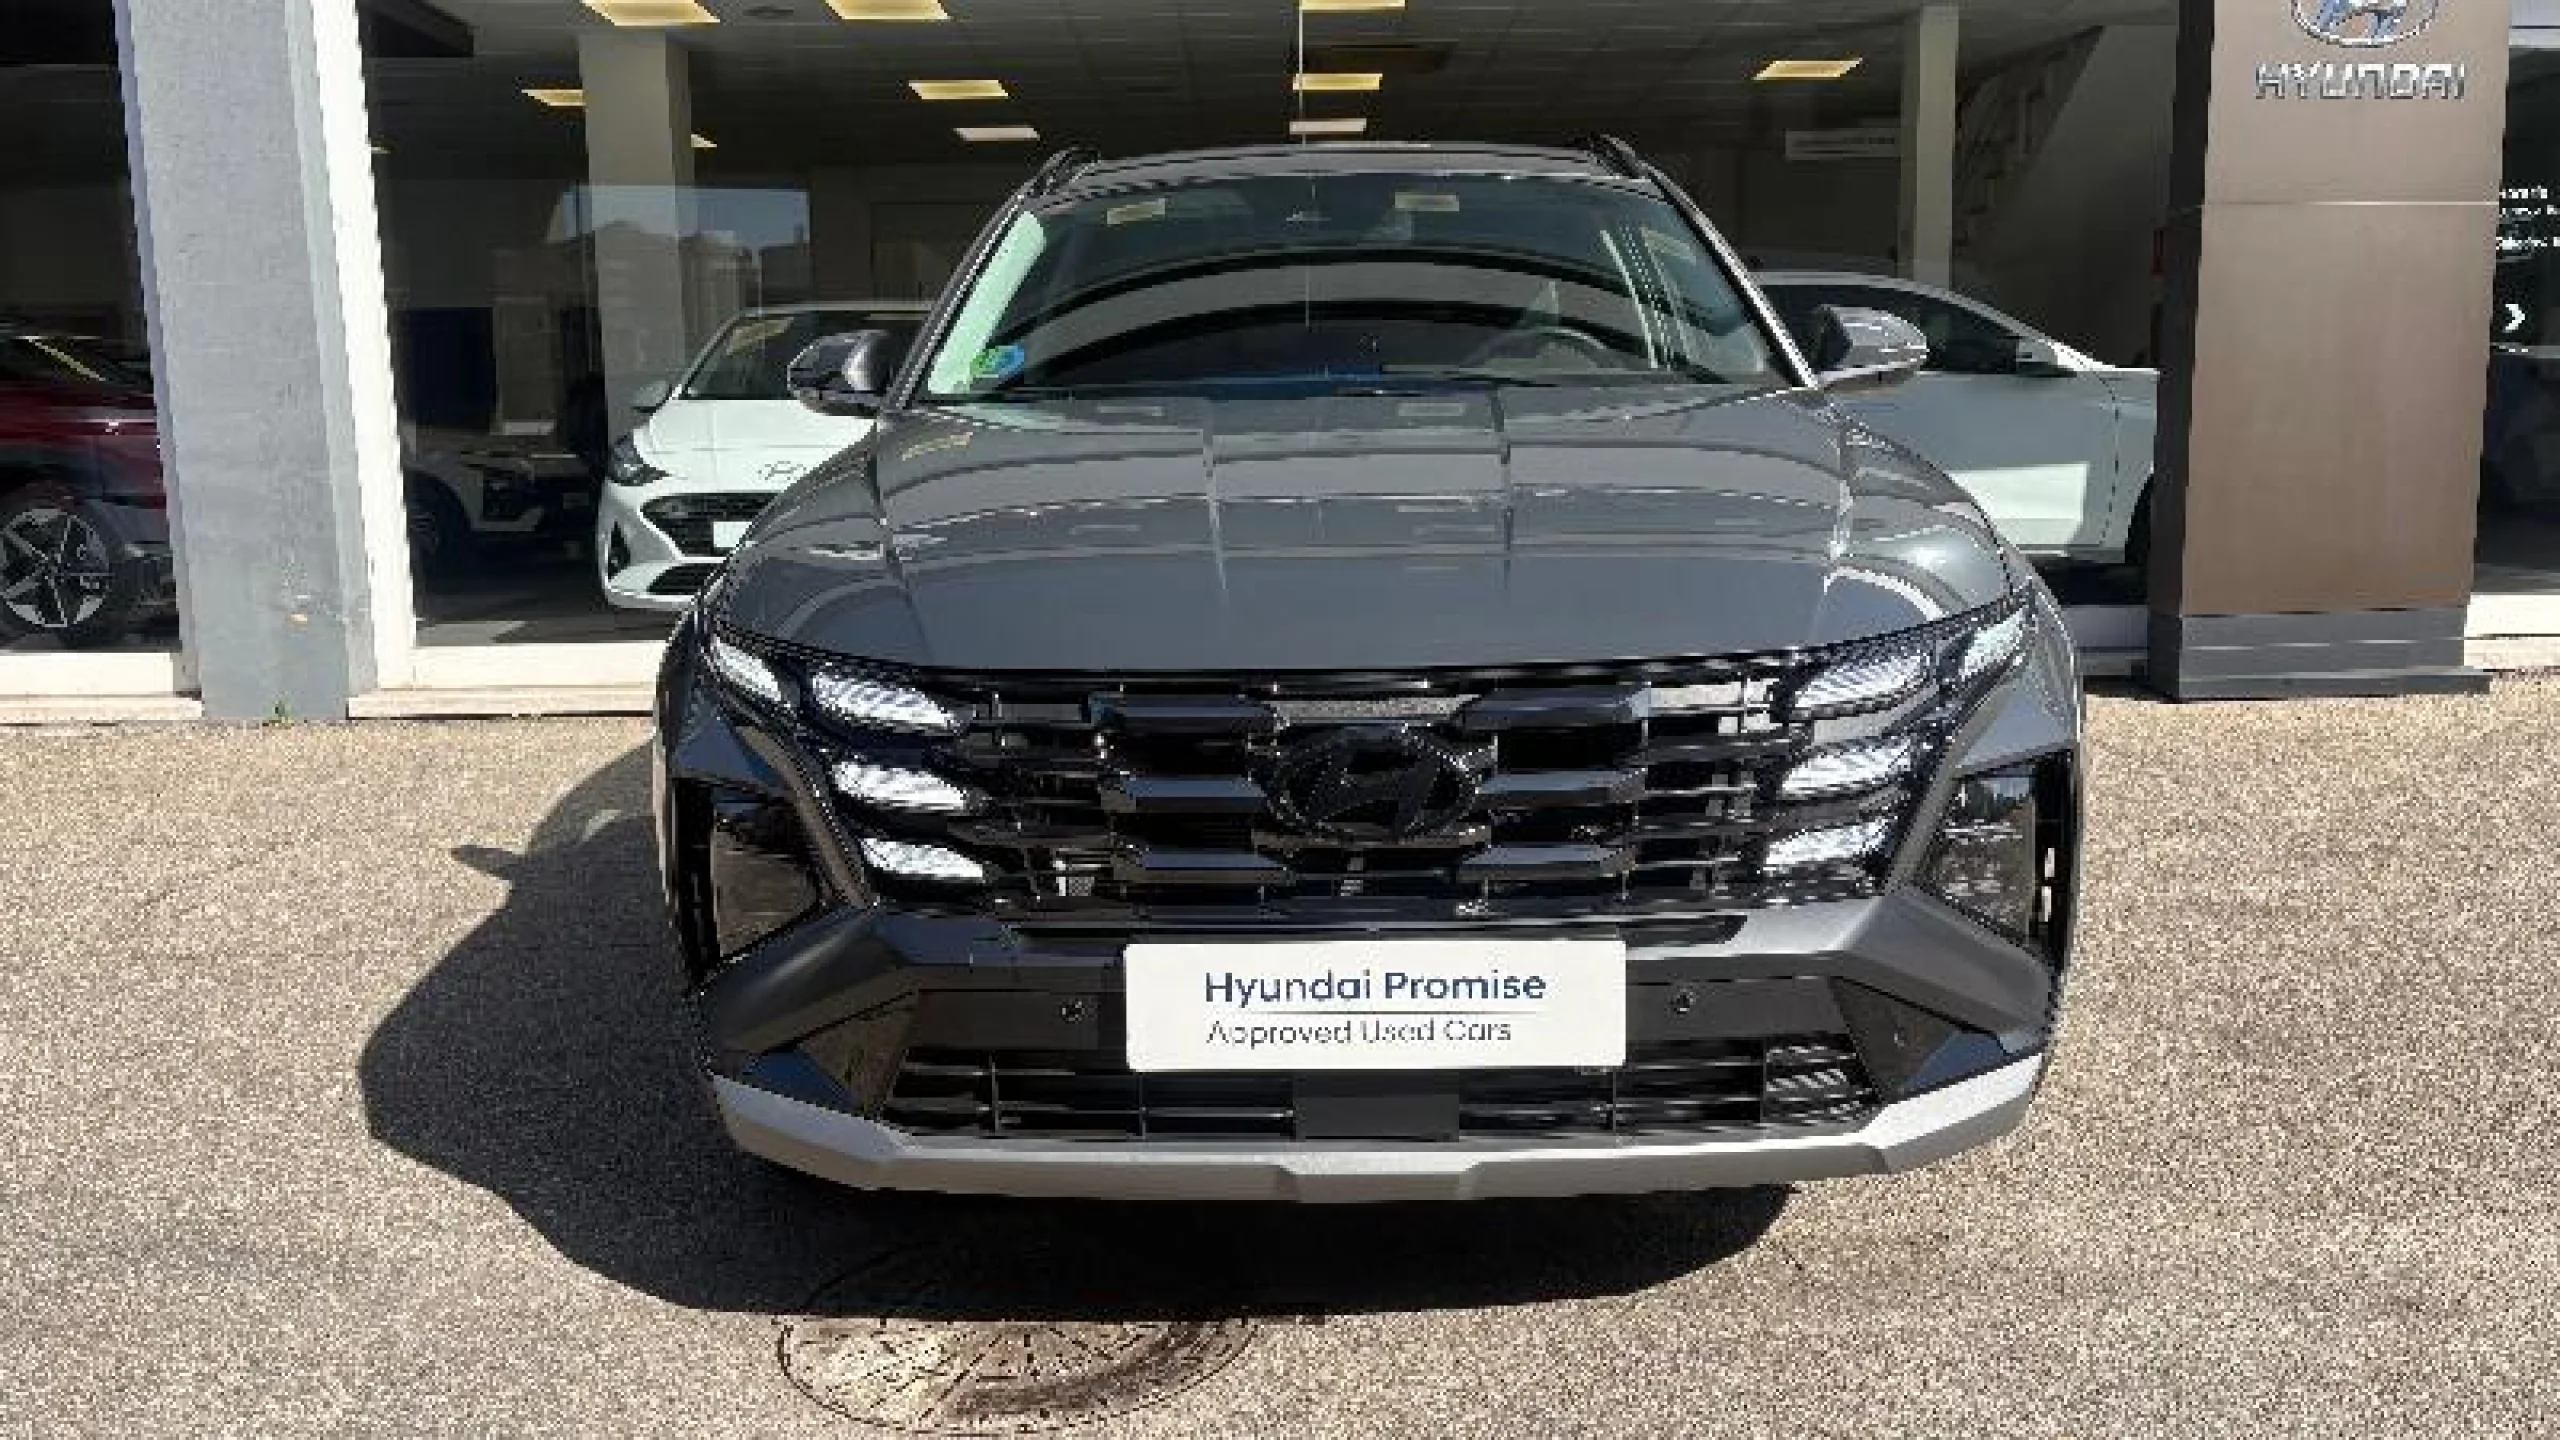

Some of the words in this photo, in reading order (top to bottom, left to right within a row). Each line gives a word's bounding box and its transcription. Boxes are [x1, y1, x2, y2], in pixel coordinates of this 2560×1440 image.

[2255, 61, 2465, 100] HYUNDAI
[1205, 969, 1371, 1008] Hyundai
[1385, 970, 1547, 1001] Promise
[1206, 1020, 1351, 1049] Approved
[1363, 1018, 1434, 1044] Used
[1445, 1019, 1512, 1043] Cars
